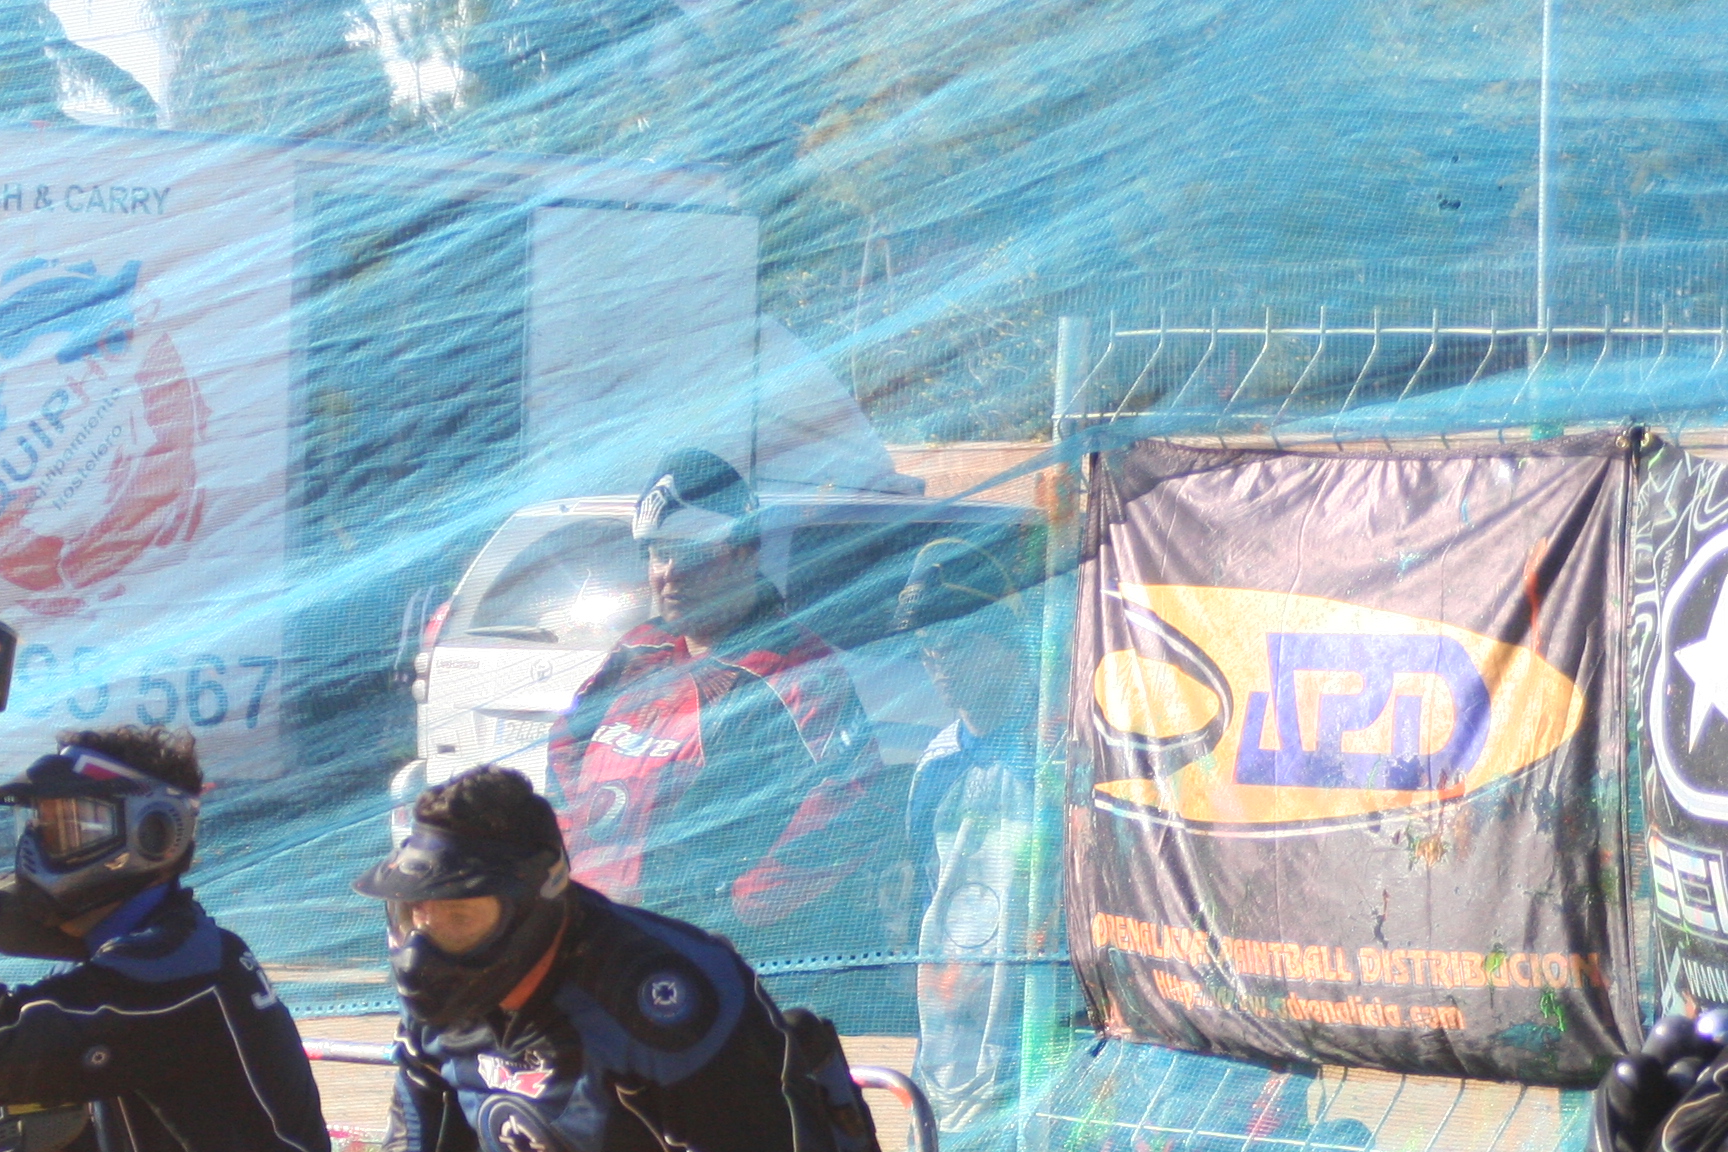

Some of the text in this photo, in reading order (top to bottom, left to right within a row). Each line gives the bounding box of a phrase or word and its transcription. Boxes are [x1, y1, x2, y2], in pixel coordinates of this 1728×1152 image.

[34, 183, 56, 214] &
[63, 185, 171, 216] CARRY
[137, 653, 280, 730] 567
